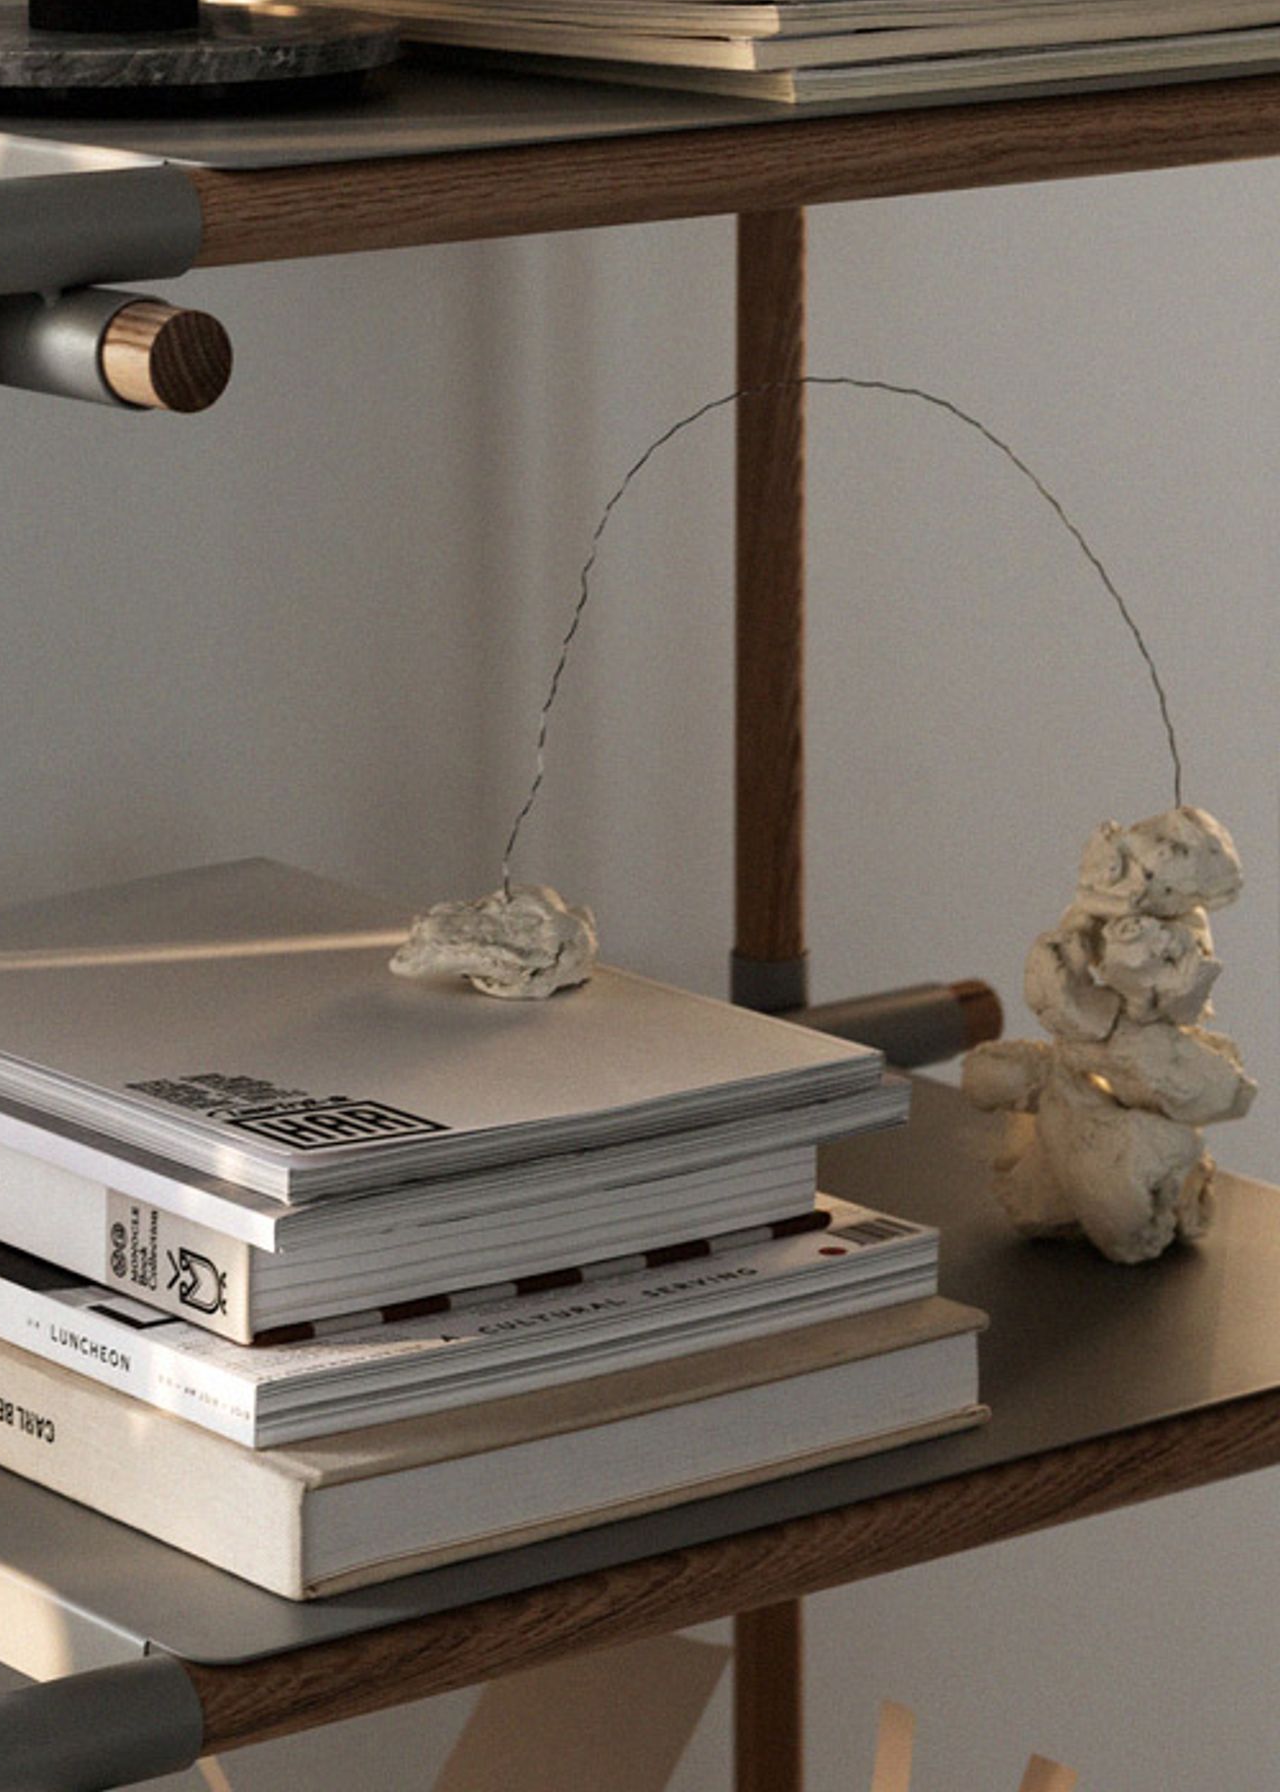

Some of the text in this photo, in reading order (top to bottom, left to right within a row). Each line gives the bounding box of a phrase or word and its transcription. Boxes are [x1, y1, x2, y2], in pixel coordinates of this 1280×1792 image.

[130, 1206, 139, 1282] MONOCLE
[477, 1297, 629, 1337] CULTURAL
[640, 1266, 759, 1299] SERVING
[50, 1323, 132, 1372] LUNCHEON
[16, 1405, 56, 1443] CARL
